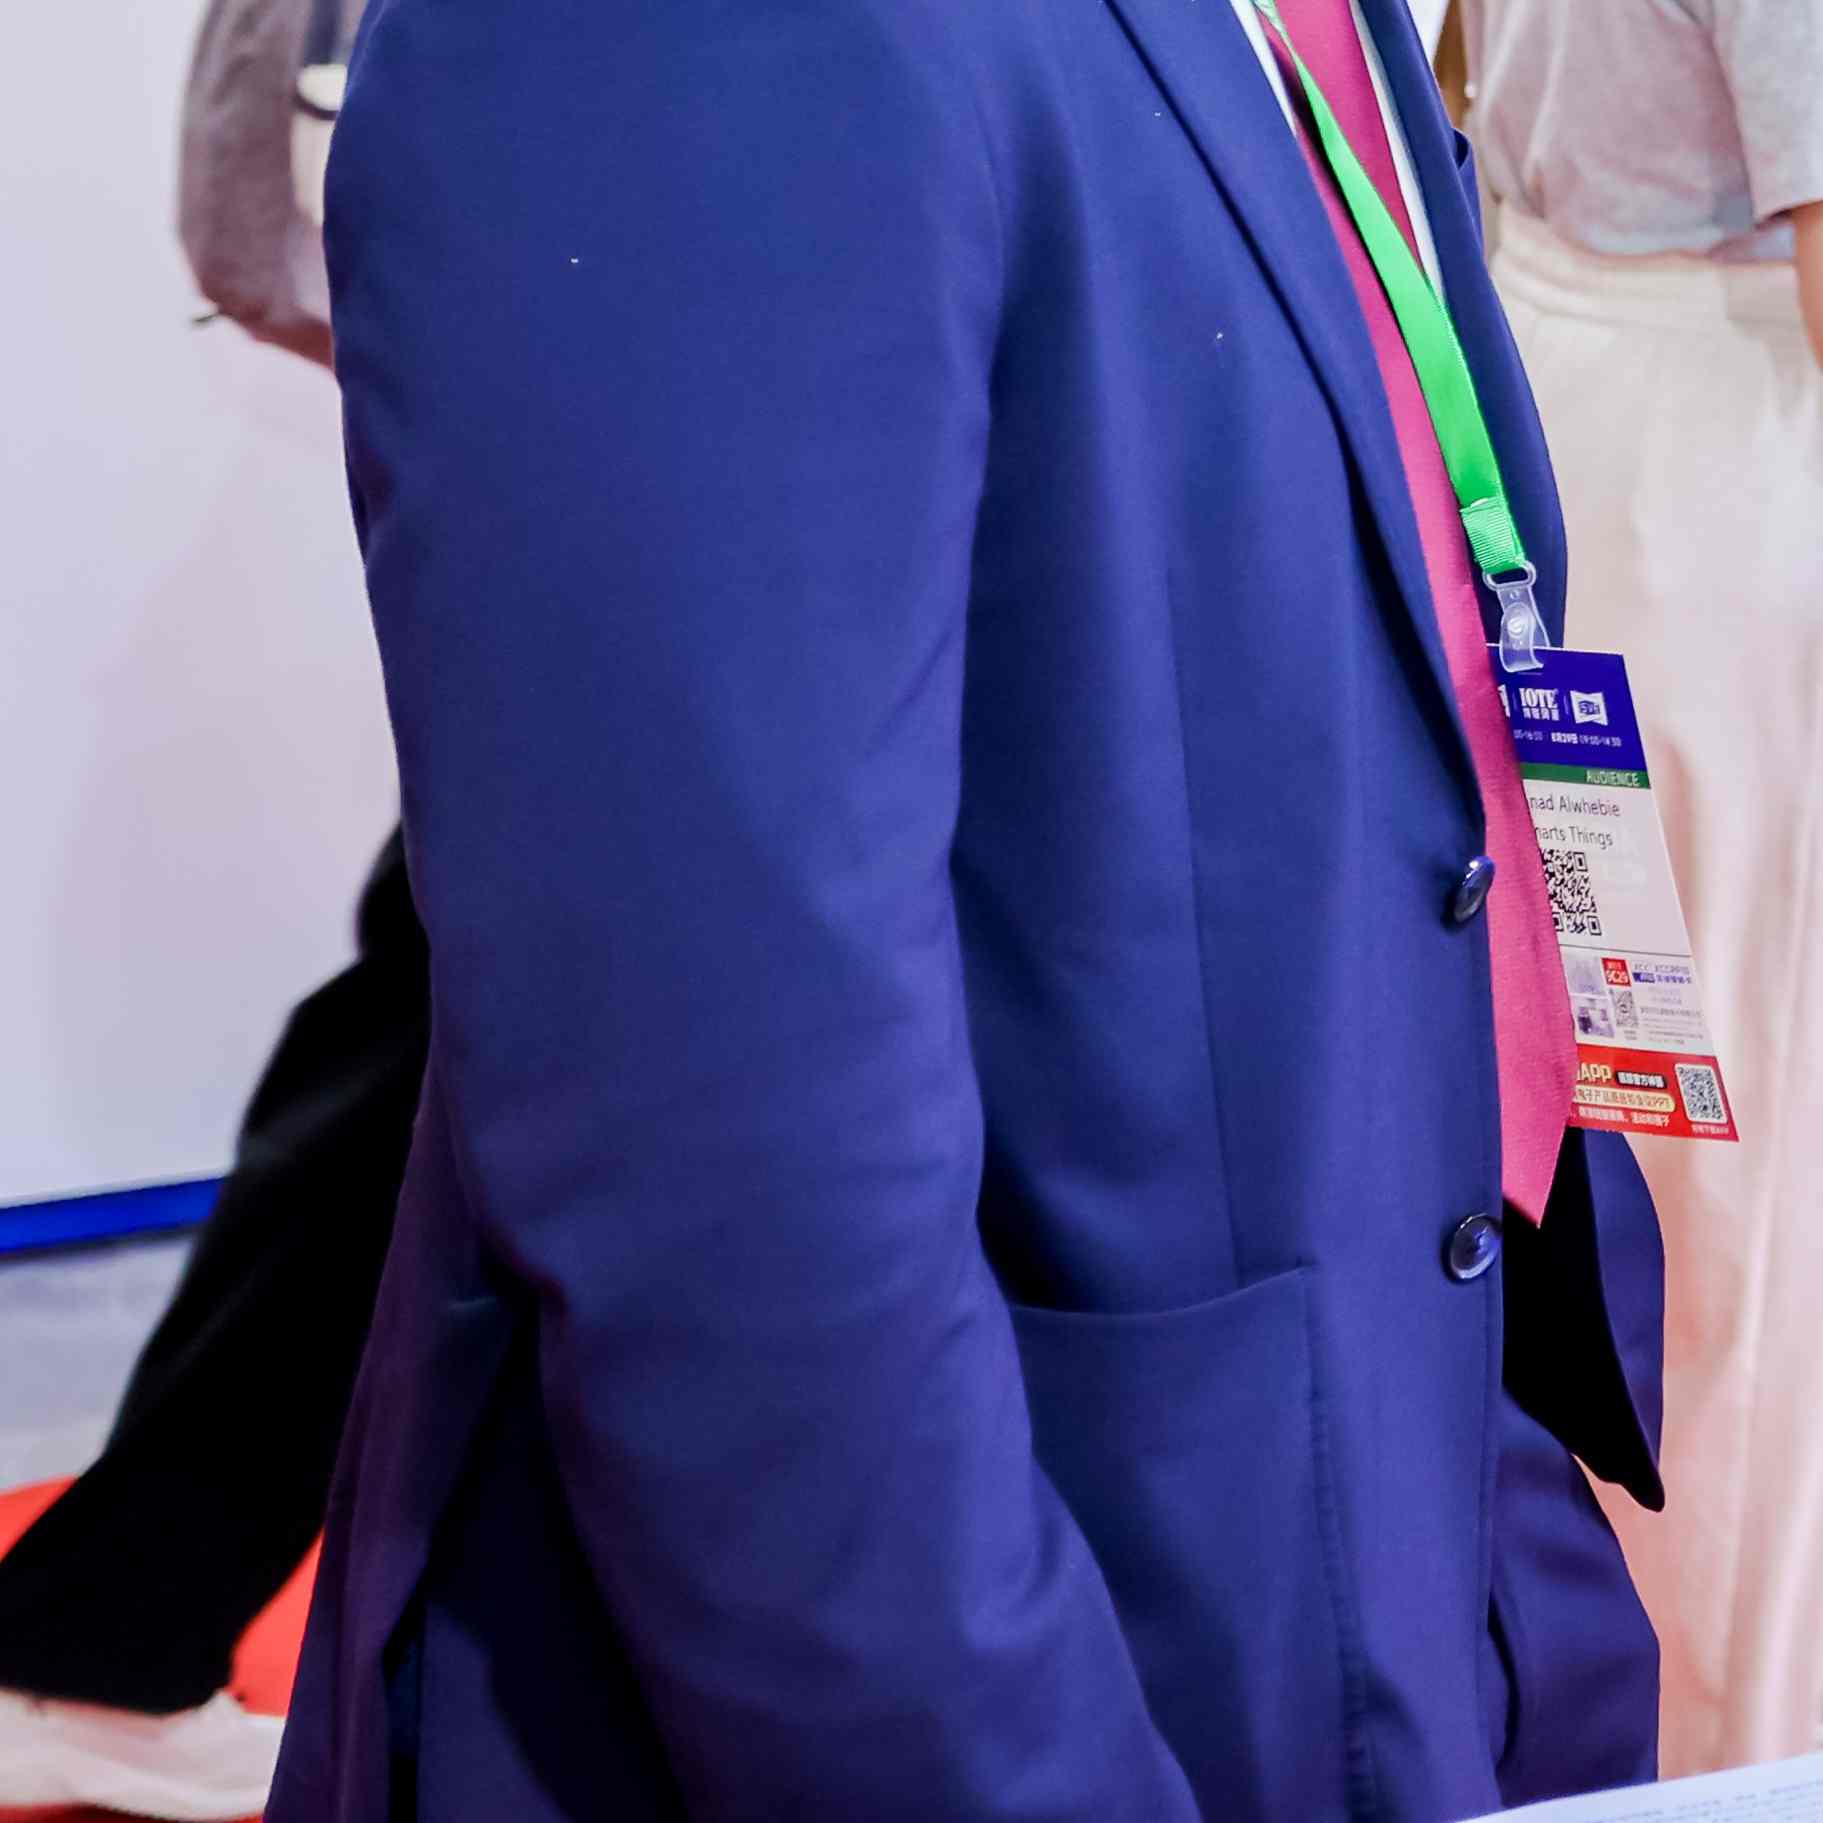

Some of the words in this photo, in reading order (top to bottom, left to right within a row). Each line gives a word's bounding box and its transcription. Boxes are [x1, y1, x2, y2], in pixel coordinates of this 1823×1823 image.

[1518, 687, 1558, 709] IOTE
[1586, 770, 1640, 787] AUDIENCE
[1568, 825, 1613, 850] Things
[1577, 1062, 1612, 1083] APP
